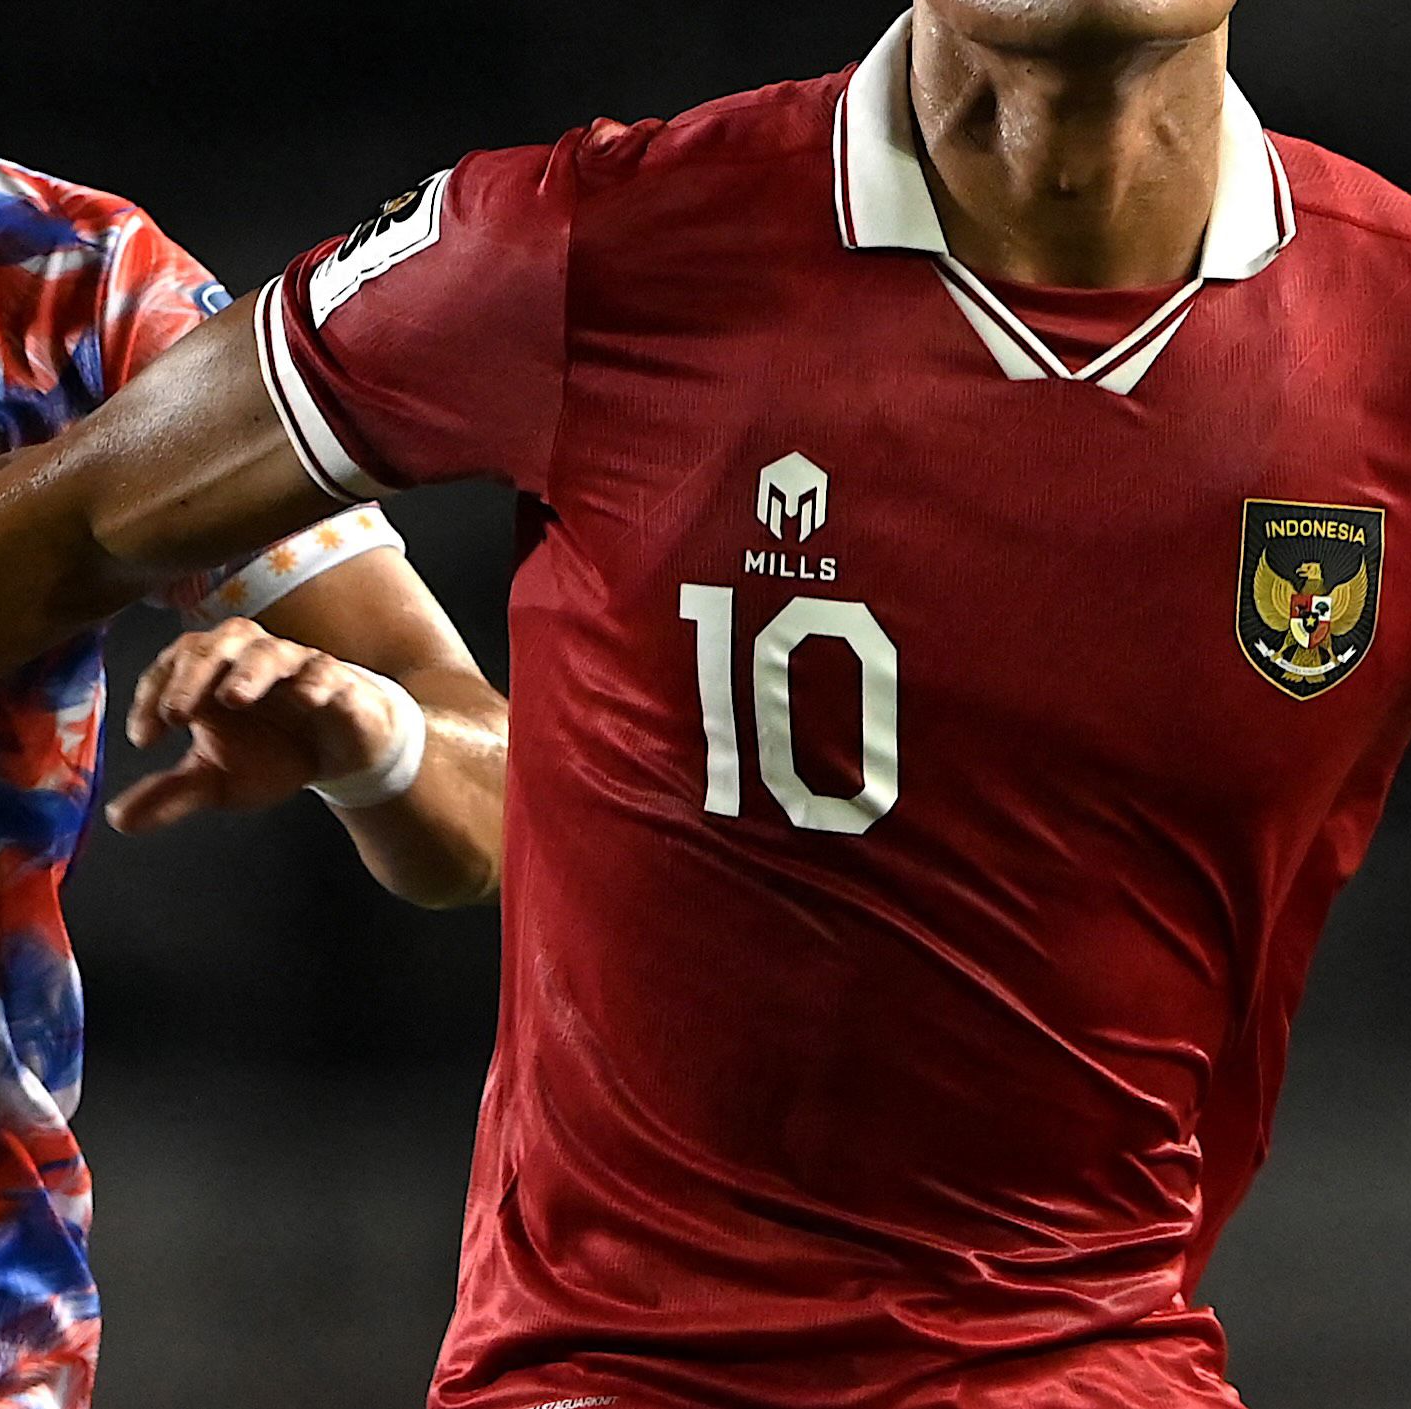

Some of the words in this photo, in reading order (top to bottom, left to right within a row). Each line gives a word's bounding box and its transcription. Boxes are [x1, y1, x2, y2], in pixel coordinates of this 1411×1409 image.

[1265, 518, 1366, 547] INDONESIA
[744, 549, 836, 581] MILLS
[679, 583, 898, 835] 10
